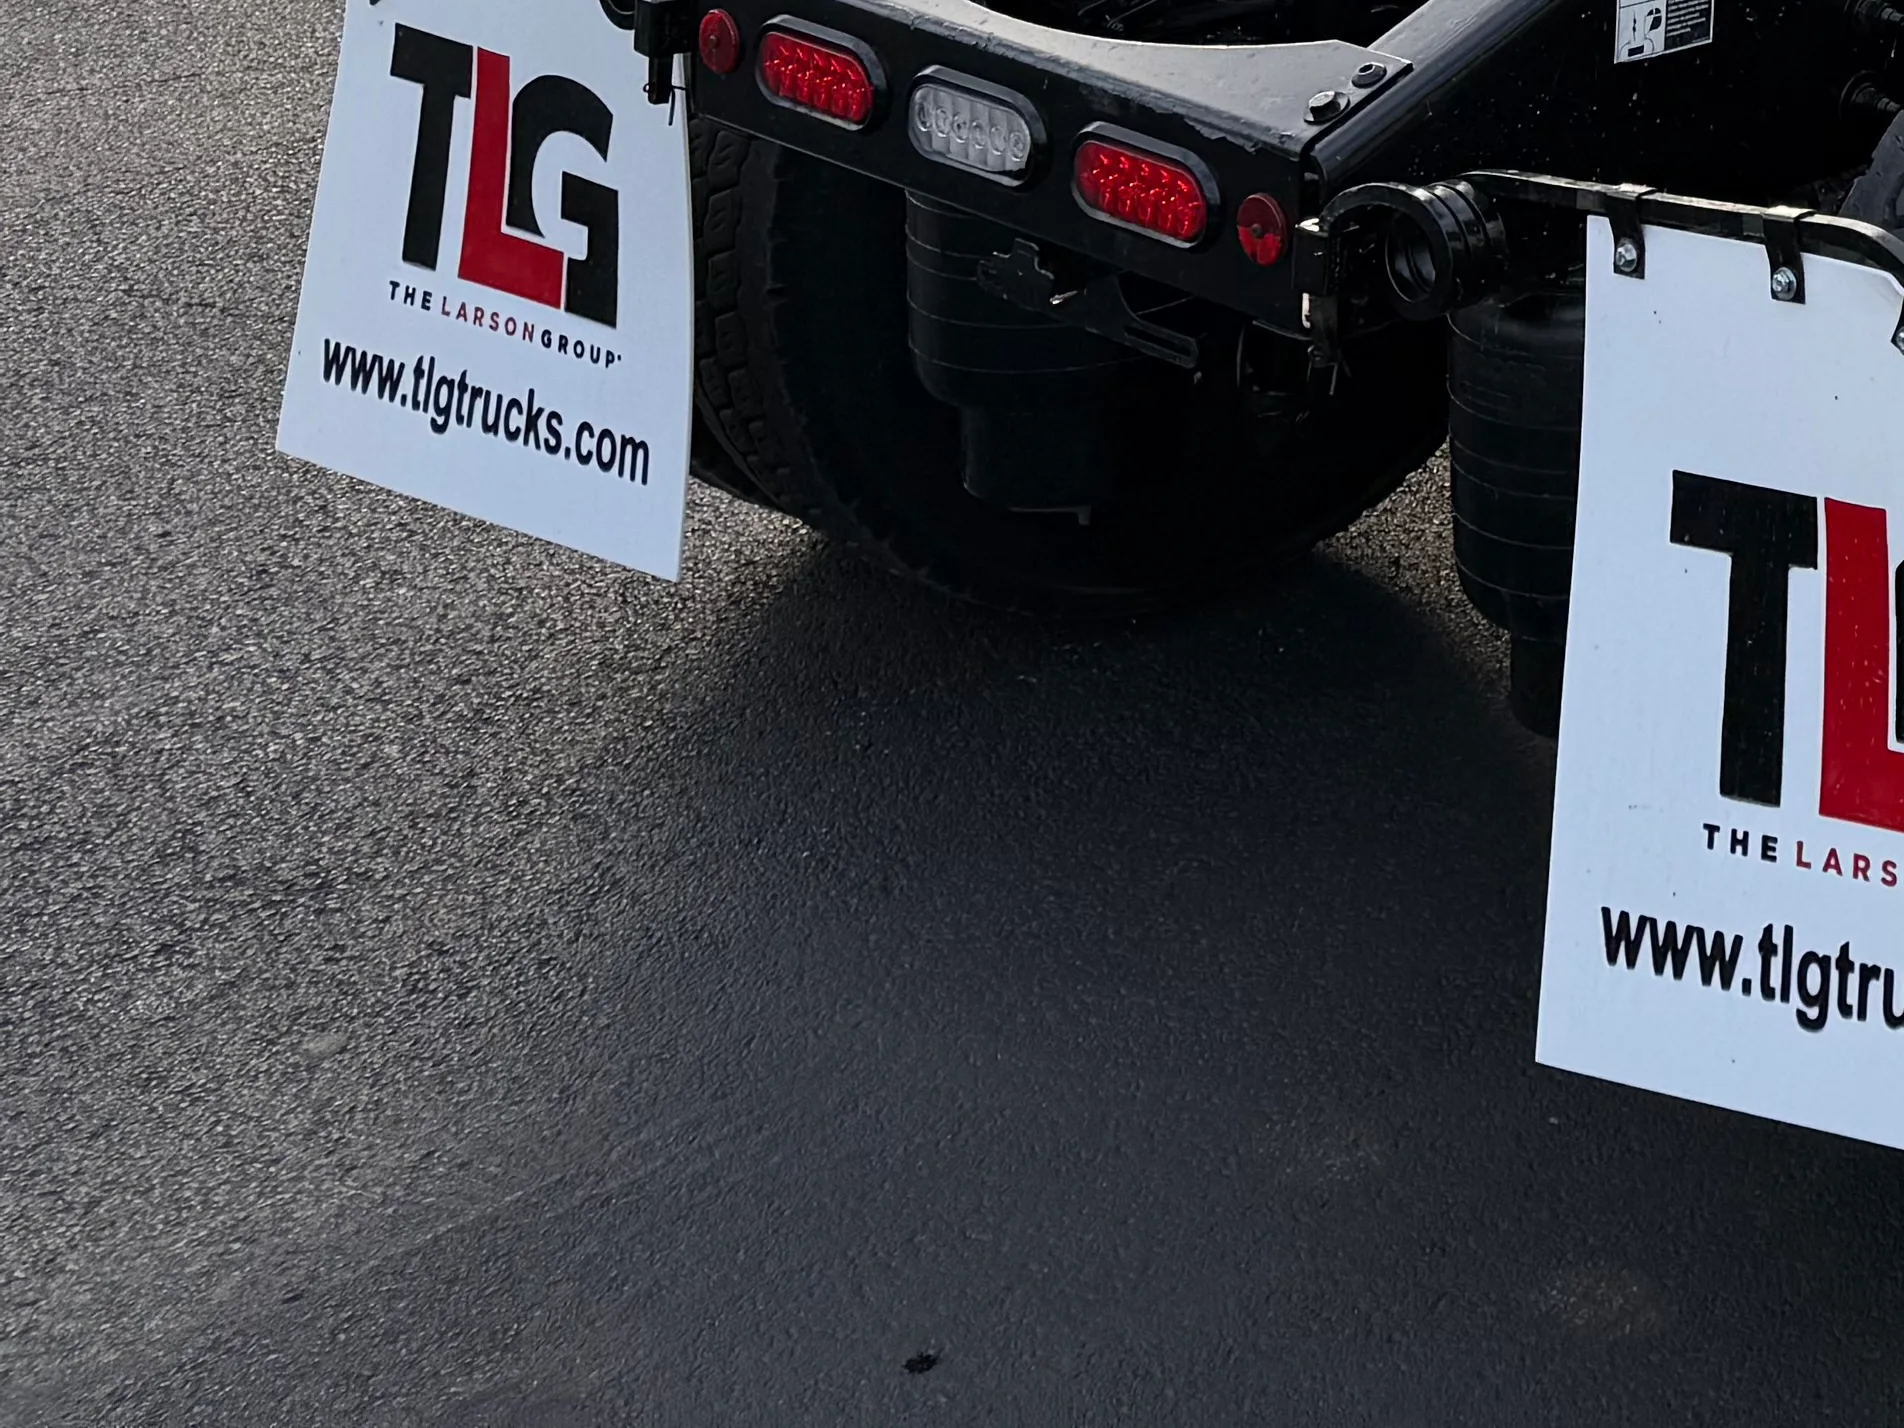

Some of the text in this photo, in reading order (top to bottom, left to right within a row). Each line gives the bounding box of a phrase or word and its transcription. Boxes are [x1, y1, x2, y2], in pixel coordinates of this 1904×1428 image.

[390, 22, 618, 329] TLG
[388, 280, 620, 369] THE LARSON GROUP
[323, 338, 650, 485] www.tlgtrucks.com
[1702, 823, 1779, 864] THE
